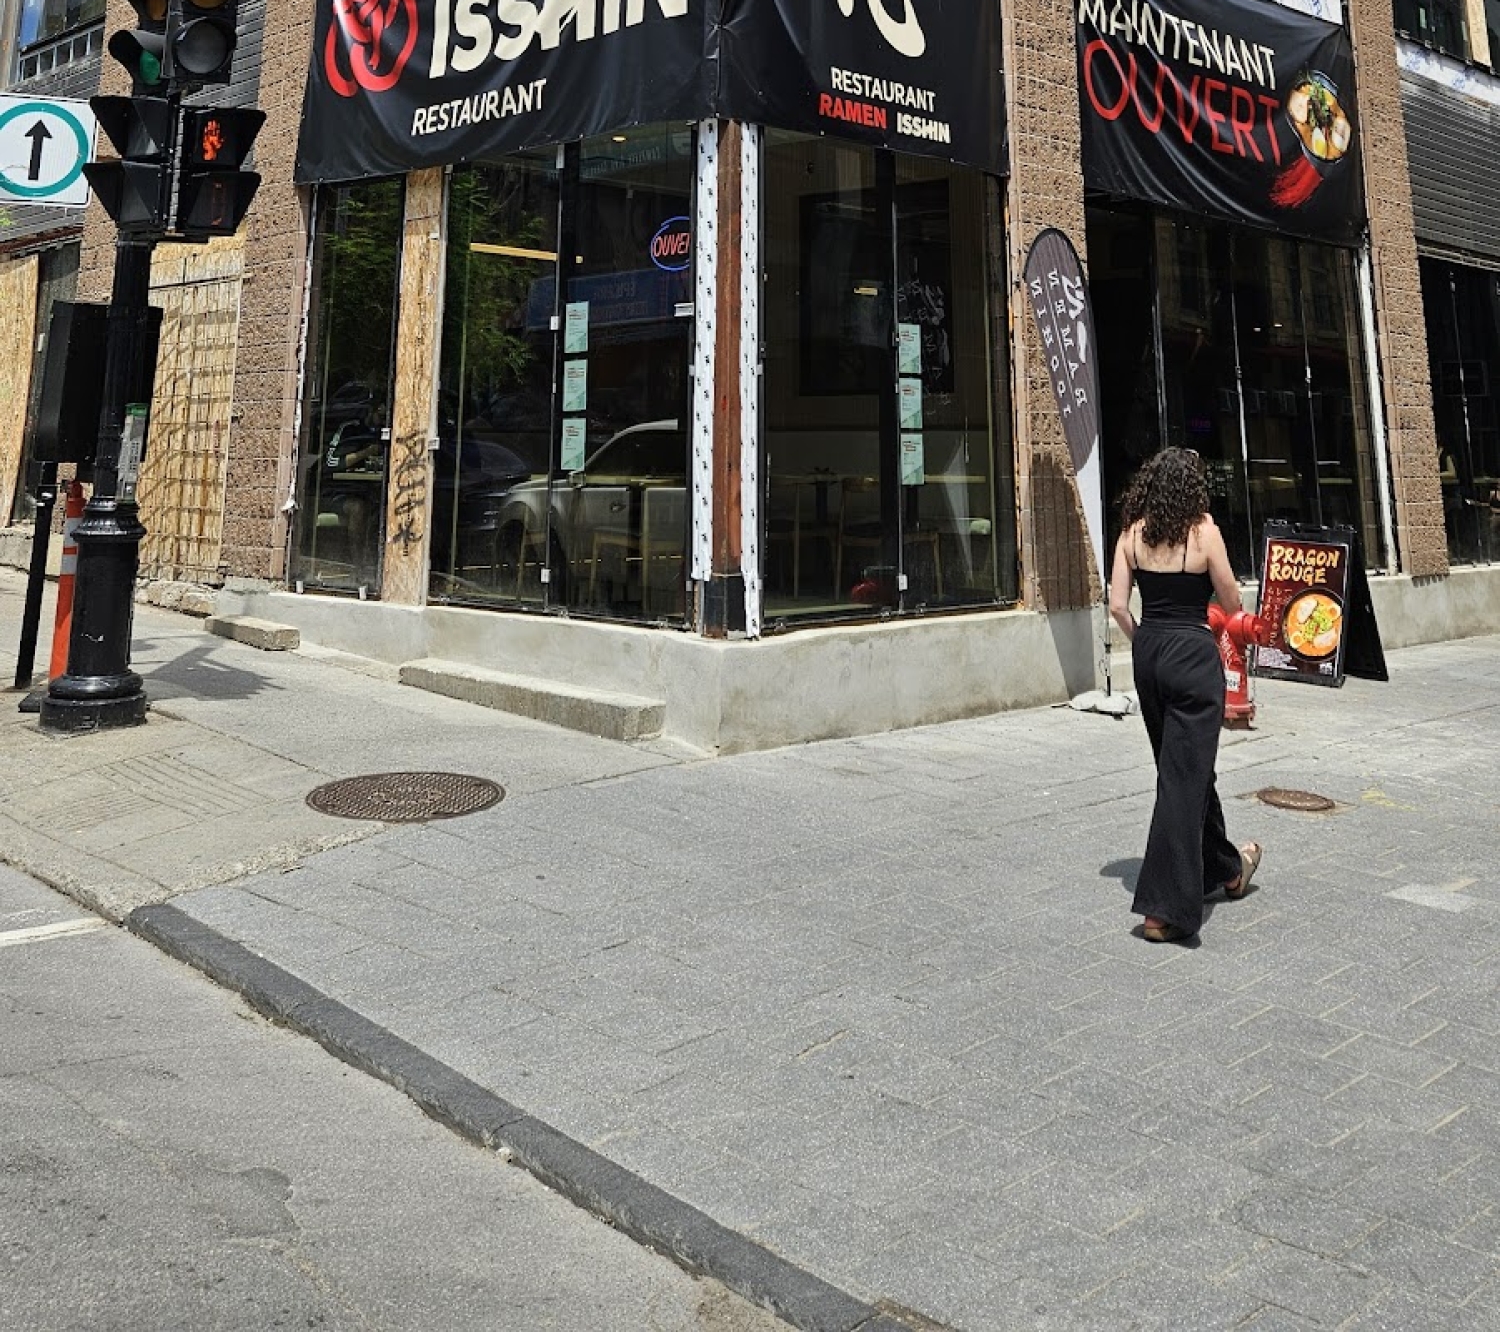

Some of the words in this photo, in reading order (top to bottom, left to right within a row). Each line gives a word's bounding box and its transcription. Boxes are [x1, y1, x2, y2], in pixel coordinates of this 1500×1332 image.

[411, 78, 547, 136] RESTAURANT
[831, 66, 936, 112] RESTAURANT
[1083, 39, 1281, 166] OUVERT
[819, 92, 887, 130] RAMEN
[896, 112, 951, 145] ISSHIN
[1269, 563, 1327, 586] ROUGE
[1271, 545, 1341, 568] DRAGON
